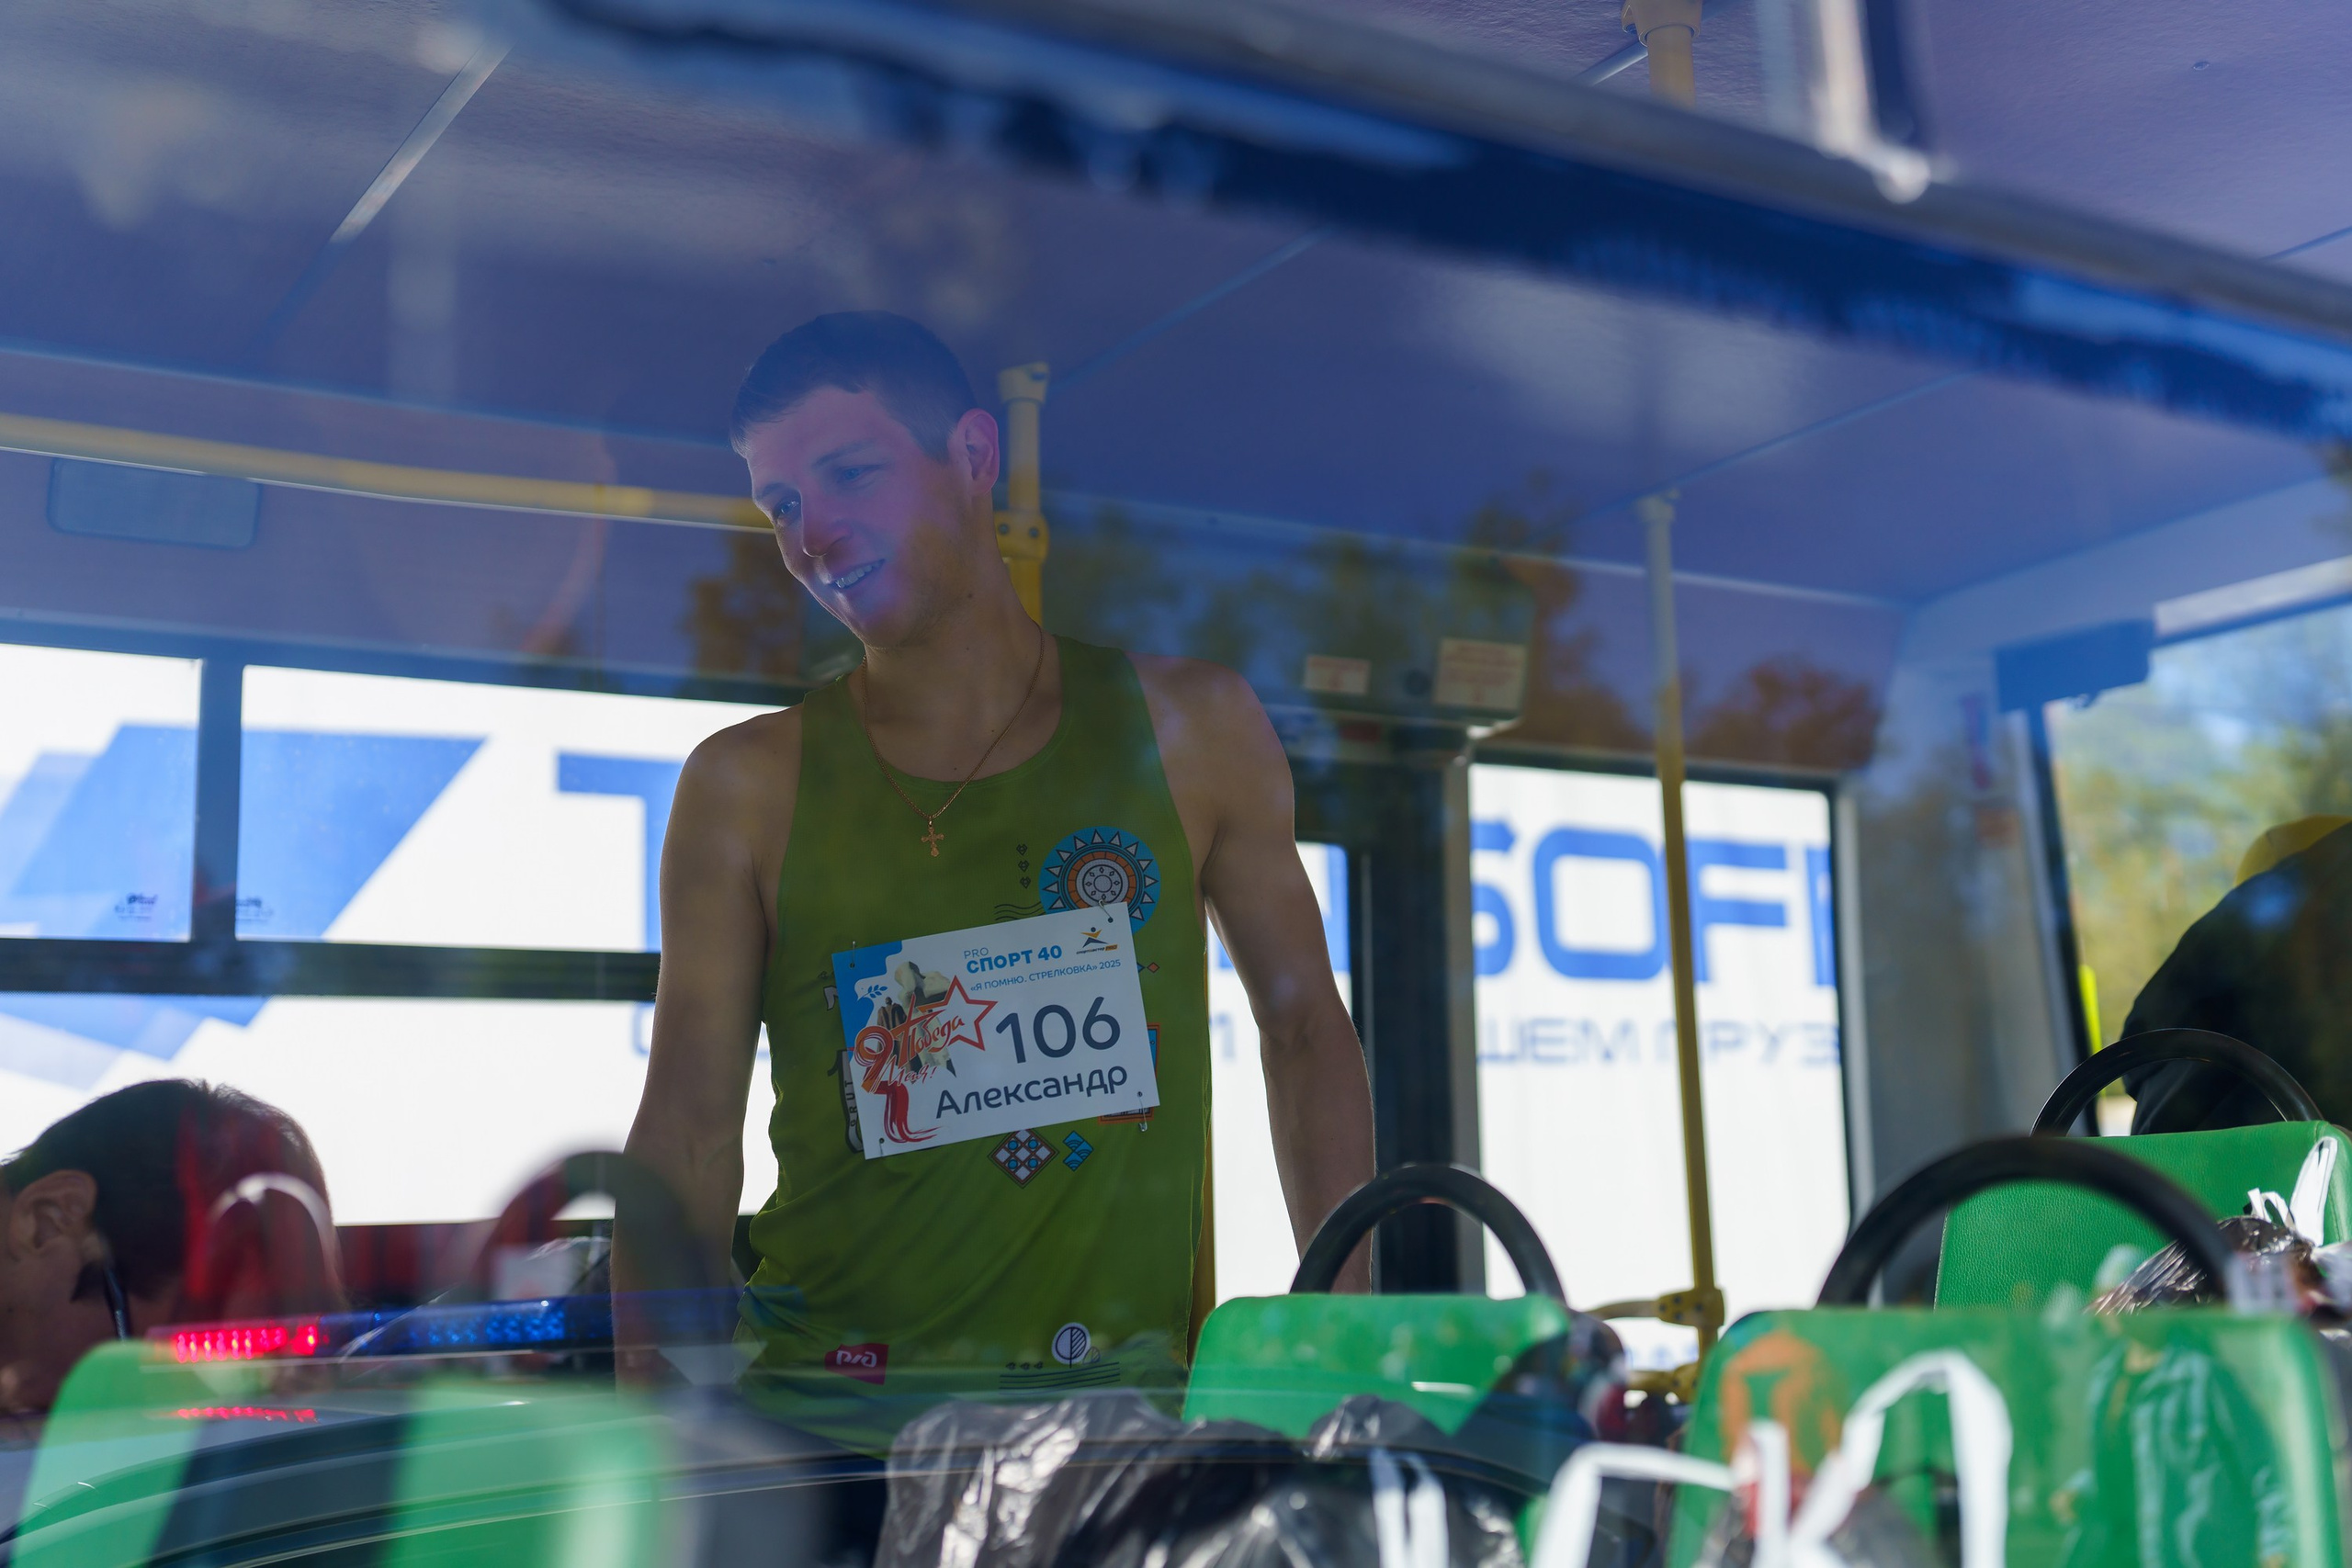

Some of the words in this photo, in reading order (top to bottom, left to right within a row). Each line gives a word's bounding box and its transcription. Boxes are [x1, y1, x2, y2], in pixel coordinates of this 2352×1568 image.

[964, 947, 989, 960] PRO
[966, 950, 1033, 974] СПОРТ
[1037, 944, 1062, 961] 40
[985, 976, 1027, 989] ПОМНЮ.
[1028, 963, 1098, 982] СТРЕЛКОВКА»
[1099, 959, 1122, 970] 2025
[995, 996, 1121, 1065] 106
[935, 1065, 1128, 1120] Александр
